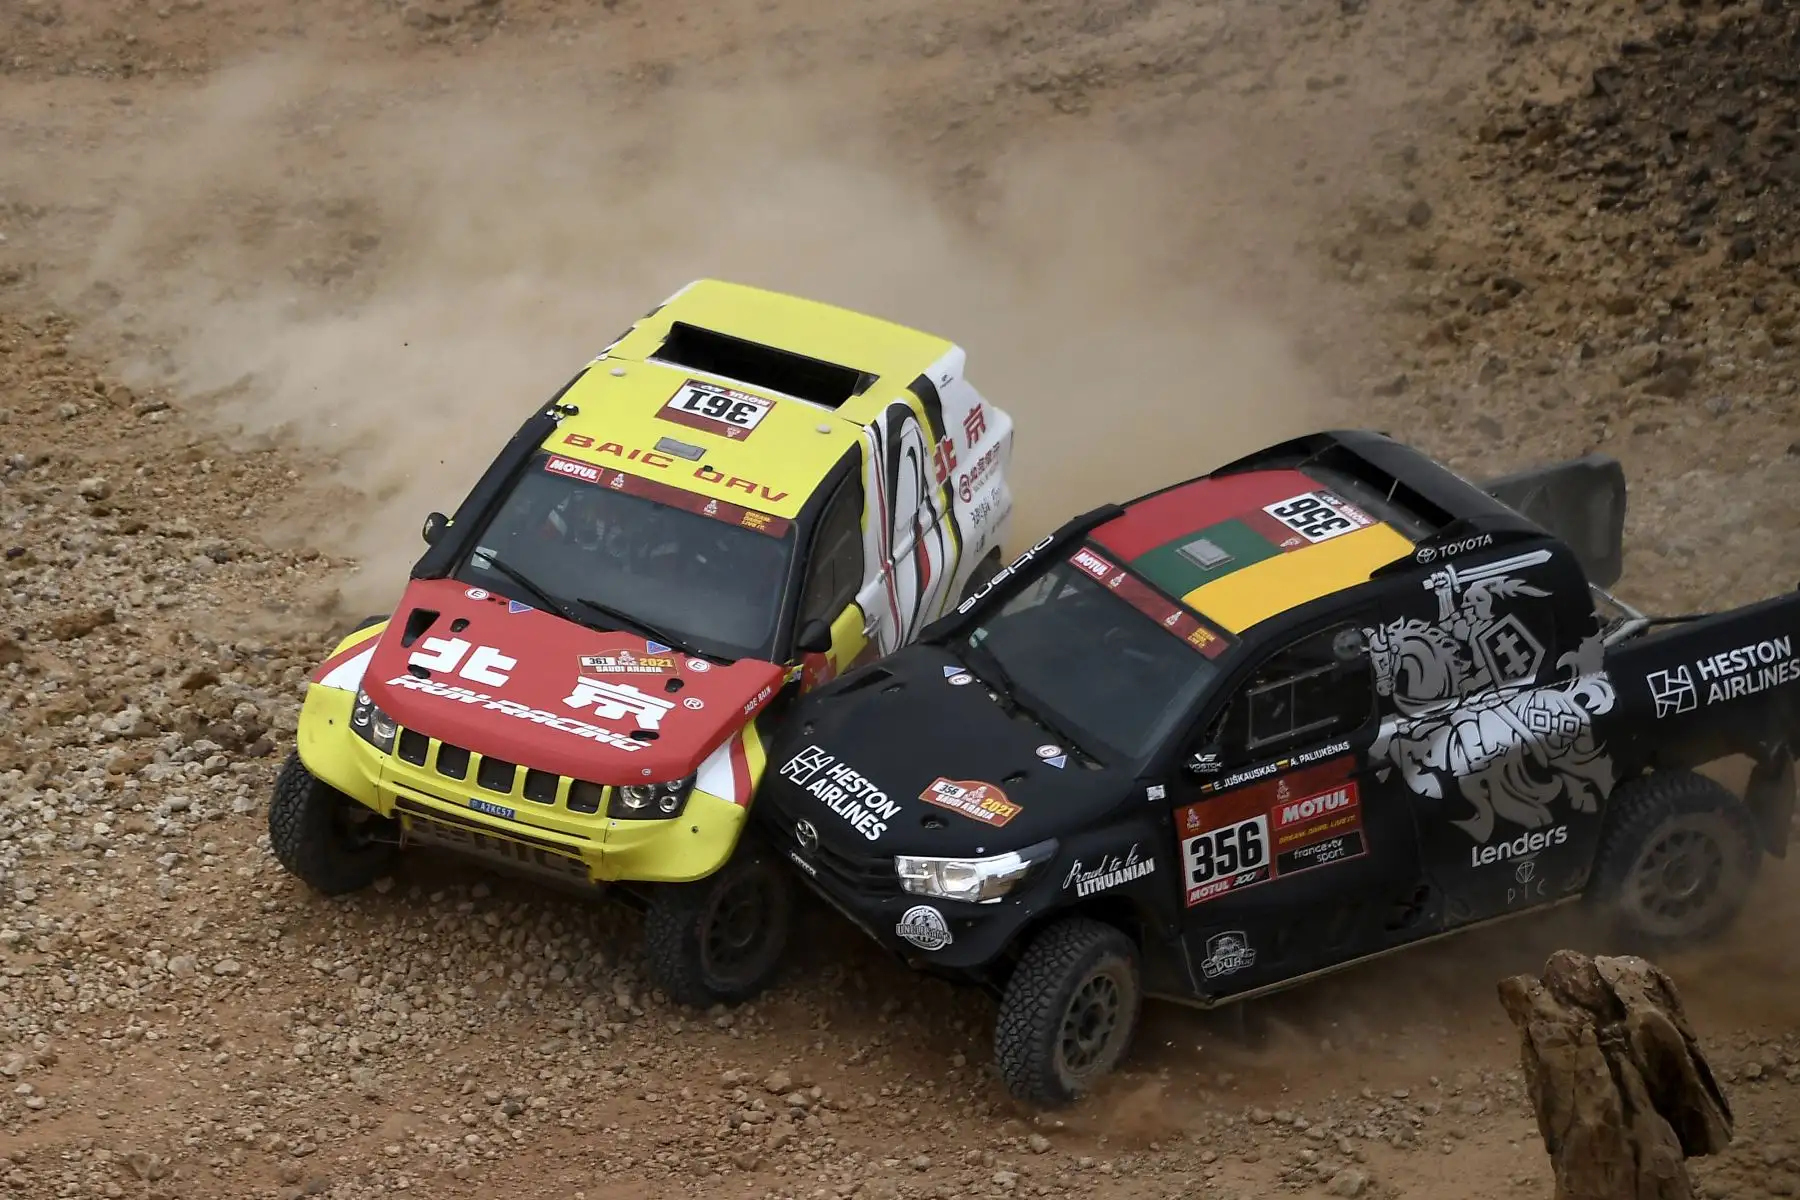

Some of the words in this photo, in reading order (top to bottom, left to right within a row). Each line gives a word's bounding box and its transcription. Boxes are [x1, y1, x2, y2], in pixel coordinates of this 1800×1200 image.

[682, 389, 758, 424] 361
[562, 433, 674, 468] BAIC
[549, 458, 597, 480] MOTUL
[1273, 498, 1351, 537] 356
[1439, 534, 1493, 558] TOYOTA
[1075, 552, 1109, 576] MOTUL
[589, 657, 608, 665] 361
[640, 658, 673, 667] 2021
[595, 665, 625, 673] SAUDI
[627, 665, 663, 673] ARABIA
[1696, 635, 1791, 681] HESTON
[1707, 658, 1800, 705] AIRLINES
[825, 762, 902, 820] HESTON
[935, 793, 963, 808] SAUDI
[960, 802, 995, 820] ARABIA
[939, 784, 959, 796] 356
[980, 798, 1015, 817] 2021
[1281, 789, 1349, 825] MOTUL
[805, 778, 888, 841] AIRLINES
[1109, 857, 1122, 873] to
[1125, 843, 1139, 867] be
[1190, 821, 1262, 883] 356
[1316, 848, 1344, 864] sport
[1471, 825, 1568, 868] Lenders
[1076, 857, 1155, 897] LITHUANIAN
[1190, 881, 1229, 902] MOTUL
